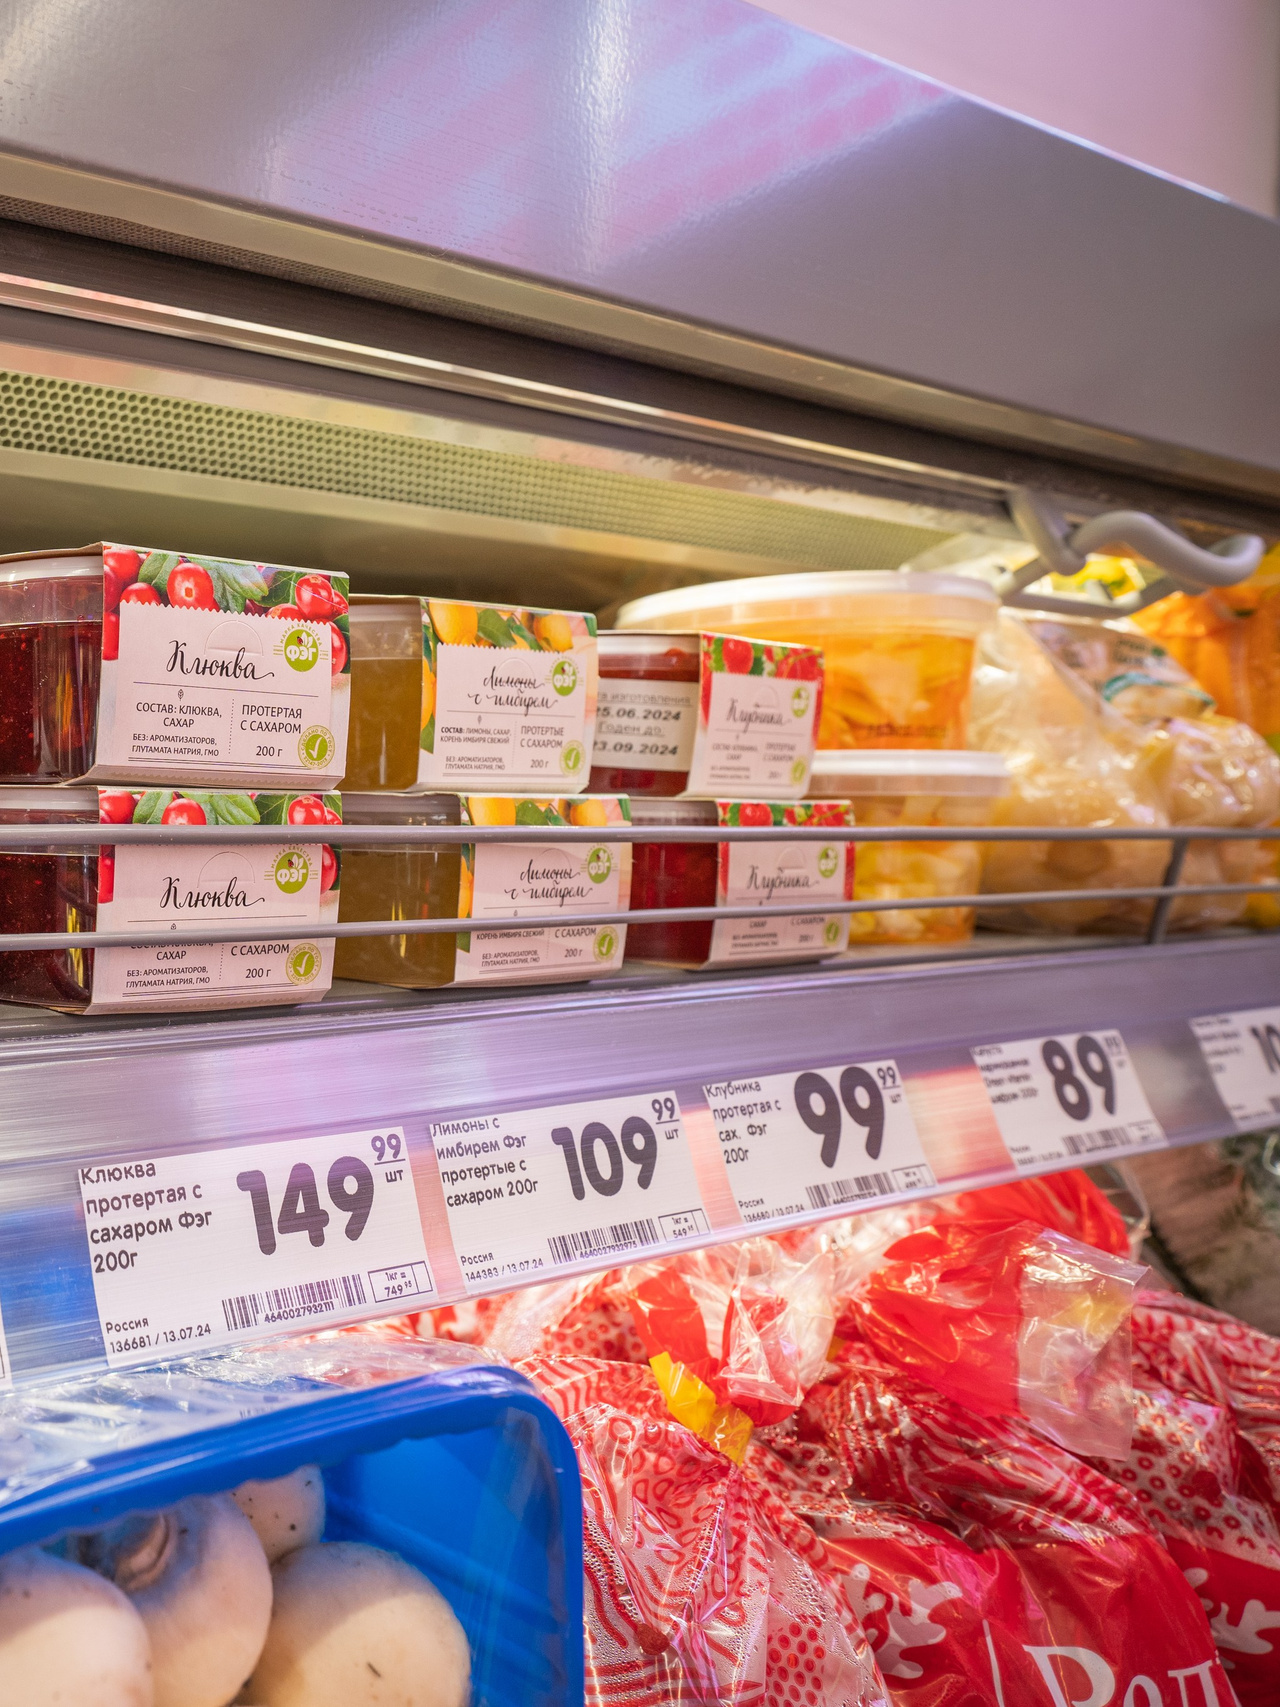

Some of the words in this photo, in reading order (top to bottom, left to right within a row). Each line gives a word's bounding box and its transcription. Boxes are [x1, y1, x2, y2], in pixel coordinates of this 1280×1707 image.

[166, 640, 275, 680] Клюква
[286, 645, 317, 662] ФЭГ
[483, 666, 545, 691] Лимоны
[553, 673, 576, 688] ФЭГ
[136, 702, 177, 715] СОСТАВ:
[179, 704, 222, 718] КЛЮКВА,
[241, 704, 302, 719] ПРОТЕРТАЯ
[486, 688, 558, 717] имбирем
[163, 717, 195, 728] САХАР
[726, 698, 792, 734] Клубника
[240, 719, 248, 731] С
[249, 720, 301, 734] САХАРОМ
[441, 726, 465, 735] СОСТАВ:
[465, 727, 492, 736] ЛИМОНЫ,
[521, 726, 564, 737] ПРОТЕРТЫЕ
[599, 721, 640, 735] Годен
[132, 734, 149, 742] БЕЗ:
[149, 735, 217, 746] АРОМАТИЗАТОРОВ,
[440, 736, 462, 744] КОРЕНЬ
[462, 736, 486, 744] ИМБИРЯ
[487, 736, 510, 744] СВЕЖИЙ
[520, 738, 526, 747] С
[526, 738, 563, 748] САХАРОМ
[131, 745, 172, 755] ГЛУТАМАТА
[173, 747, 203, 756] НАТРИЯ,
[204, 748, 219, 757] ГМО
[255, 745, 275, 757] 200
[277, 748, 283, 757] г
[276, 869, 307, 885] ФЭГ
[520, 859, 581, 885] Лимоны
[588, 861, 610, 876] ФЭГ
[747, 865, 819, 900] Клубника
[160, 876, 265, 910] Клюква
[522, 879, 593, 907] имбирем
[156, 951, 187, 961] САХАР
[230, 945, 237, 957] С
[239, 943, 290, 956] САХАРОМ
[1042, 1035, 1115, 1121] 89
[705, 1080, 762, 1099] Клубника
[713, 1101, 773, 1122] протертая
[775, 1100, 782, 1111] с
[794, 1066, 885, 1168] 99
[877, 1066, 897, 1086] 99
[432, 1119, 489, 1138] Лимоны
[492, 1117, 500, 1129] с
[664, 1128, 680, 1140] шт
[719, 1128, 742, 1143] сах.
[747, 1123, 768, 1137] Фэг
[436, 1141, 500, 1160] имбирем
[503, 1133, 527, 1149] Фэг
[550, 1115, 658, 1201] 109
[651, 1097, 676, 1121] 99
[724, 1147, 750, 1165] 200г
[80, 1161, 157, 1185] Клюква
[385, 1169, 404, 1183] шт
[441, 1163, 516, 1186] протертые
[519, 1159, 527, 1171] с
[86, 1188, 187, 1216] протертая
[192, 1184, 203, 1199] с
[236, 1156, 375, 1255] 149
[370, 1133, 402, 1162] 99
[446, 1188, 504, 1208] сахаром
[506, 1178, 538, 1198] 200г
[738, 1198, 765, 1209] Россия
[744, 1211, 770, 1223] 136680
[776, 1203, 805, 1216] 13.07.24
[90, 1218, 174, 1245] сахаром
[178, 1210, 213, 1230] Фэг
[93, 1249, 139, 1274] 200г
[460, 1252, 495, 1267] Россия
[465, 1266, 500, 1283] 144383
[506, 1258, 544, 1274] 13.07.24
[384, 1285, 404, 1298] 749
[105, 1316, 149, 1335] Россия
[109, 1335, 151, 1355] 136681
[162, 1323, 212, 1343] 13.07.24
[263, 1300, 335, 1324] 4640027932111
